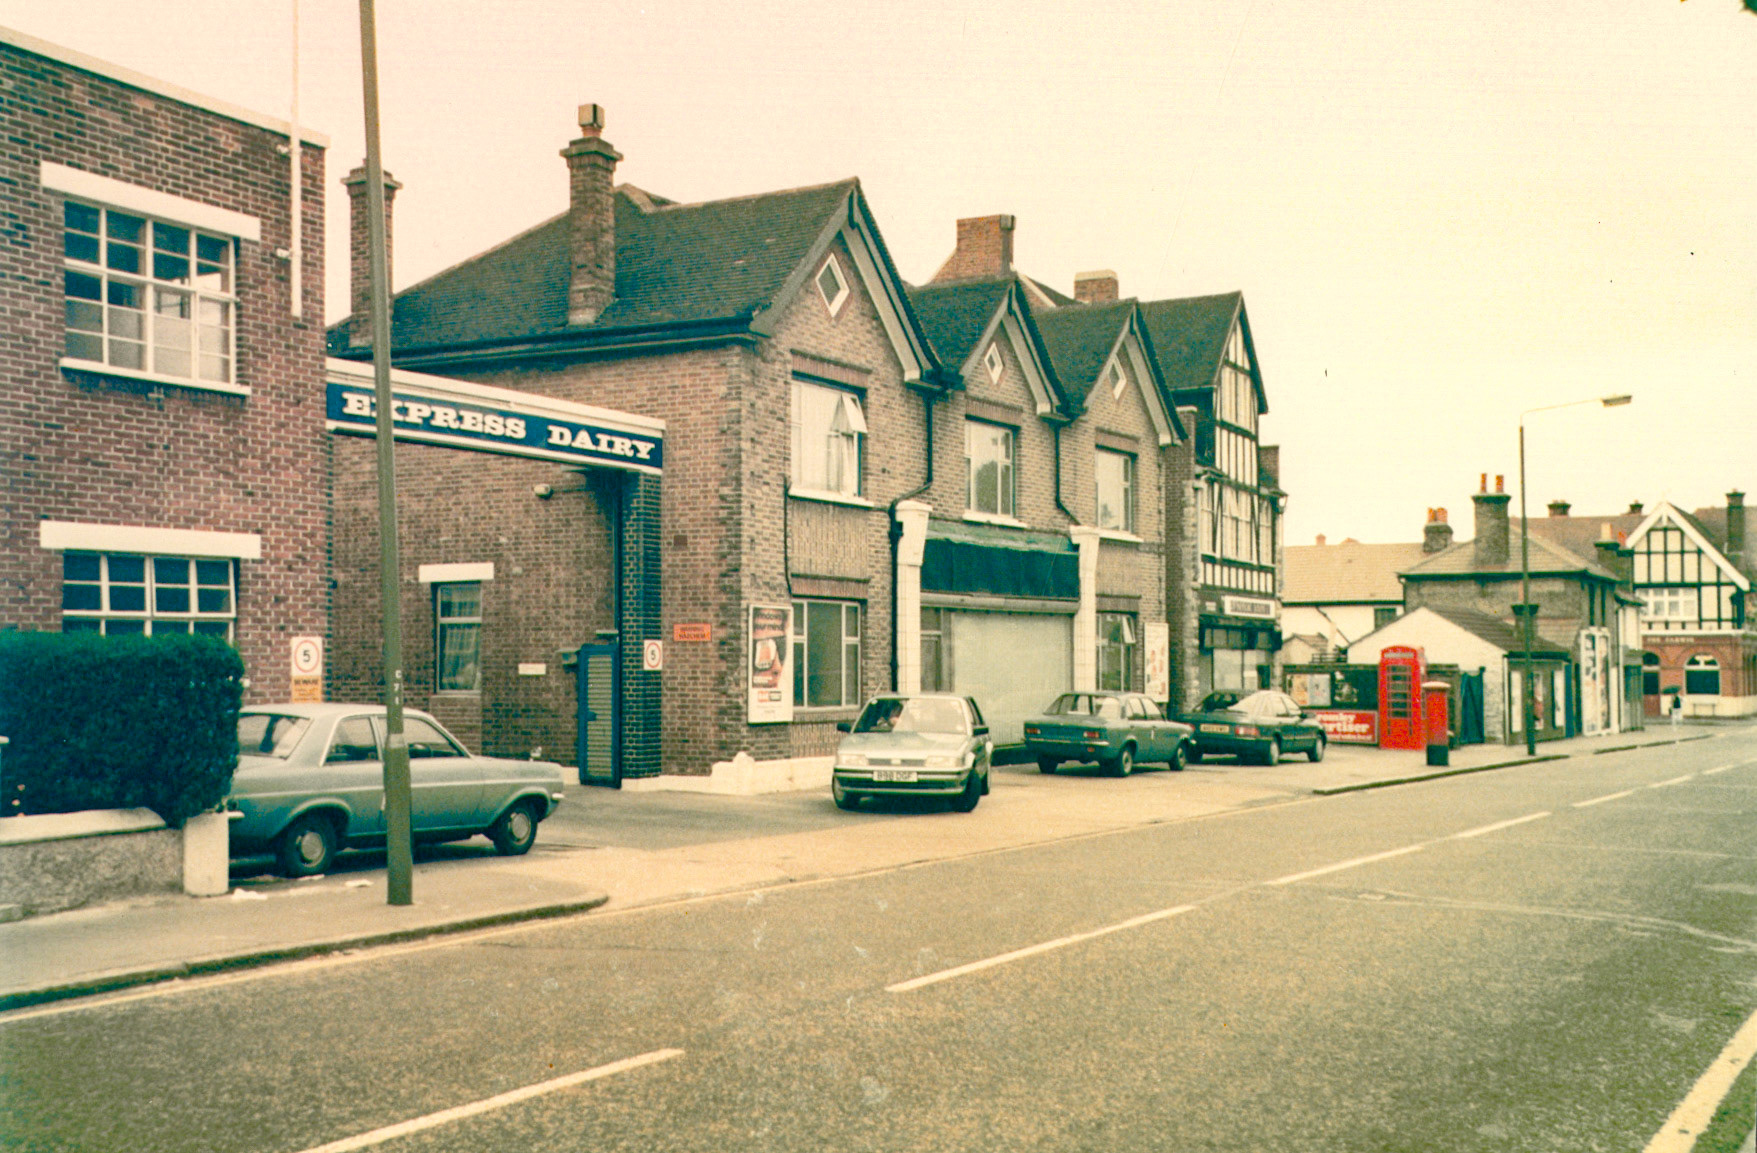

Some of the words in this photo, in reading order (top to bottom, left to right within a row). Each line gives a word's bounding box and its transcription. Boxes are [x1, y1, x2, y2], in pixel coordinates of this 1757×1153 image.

[342, 391, 527, 439] EXPRESS
[547, 425, 655, 459] DAIRY
[303, 650, 310, 662] 5
[650, 649, 657, 661] 5
